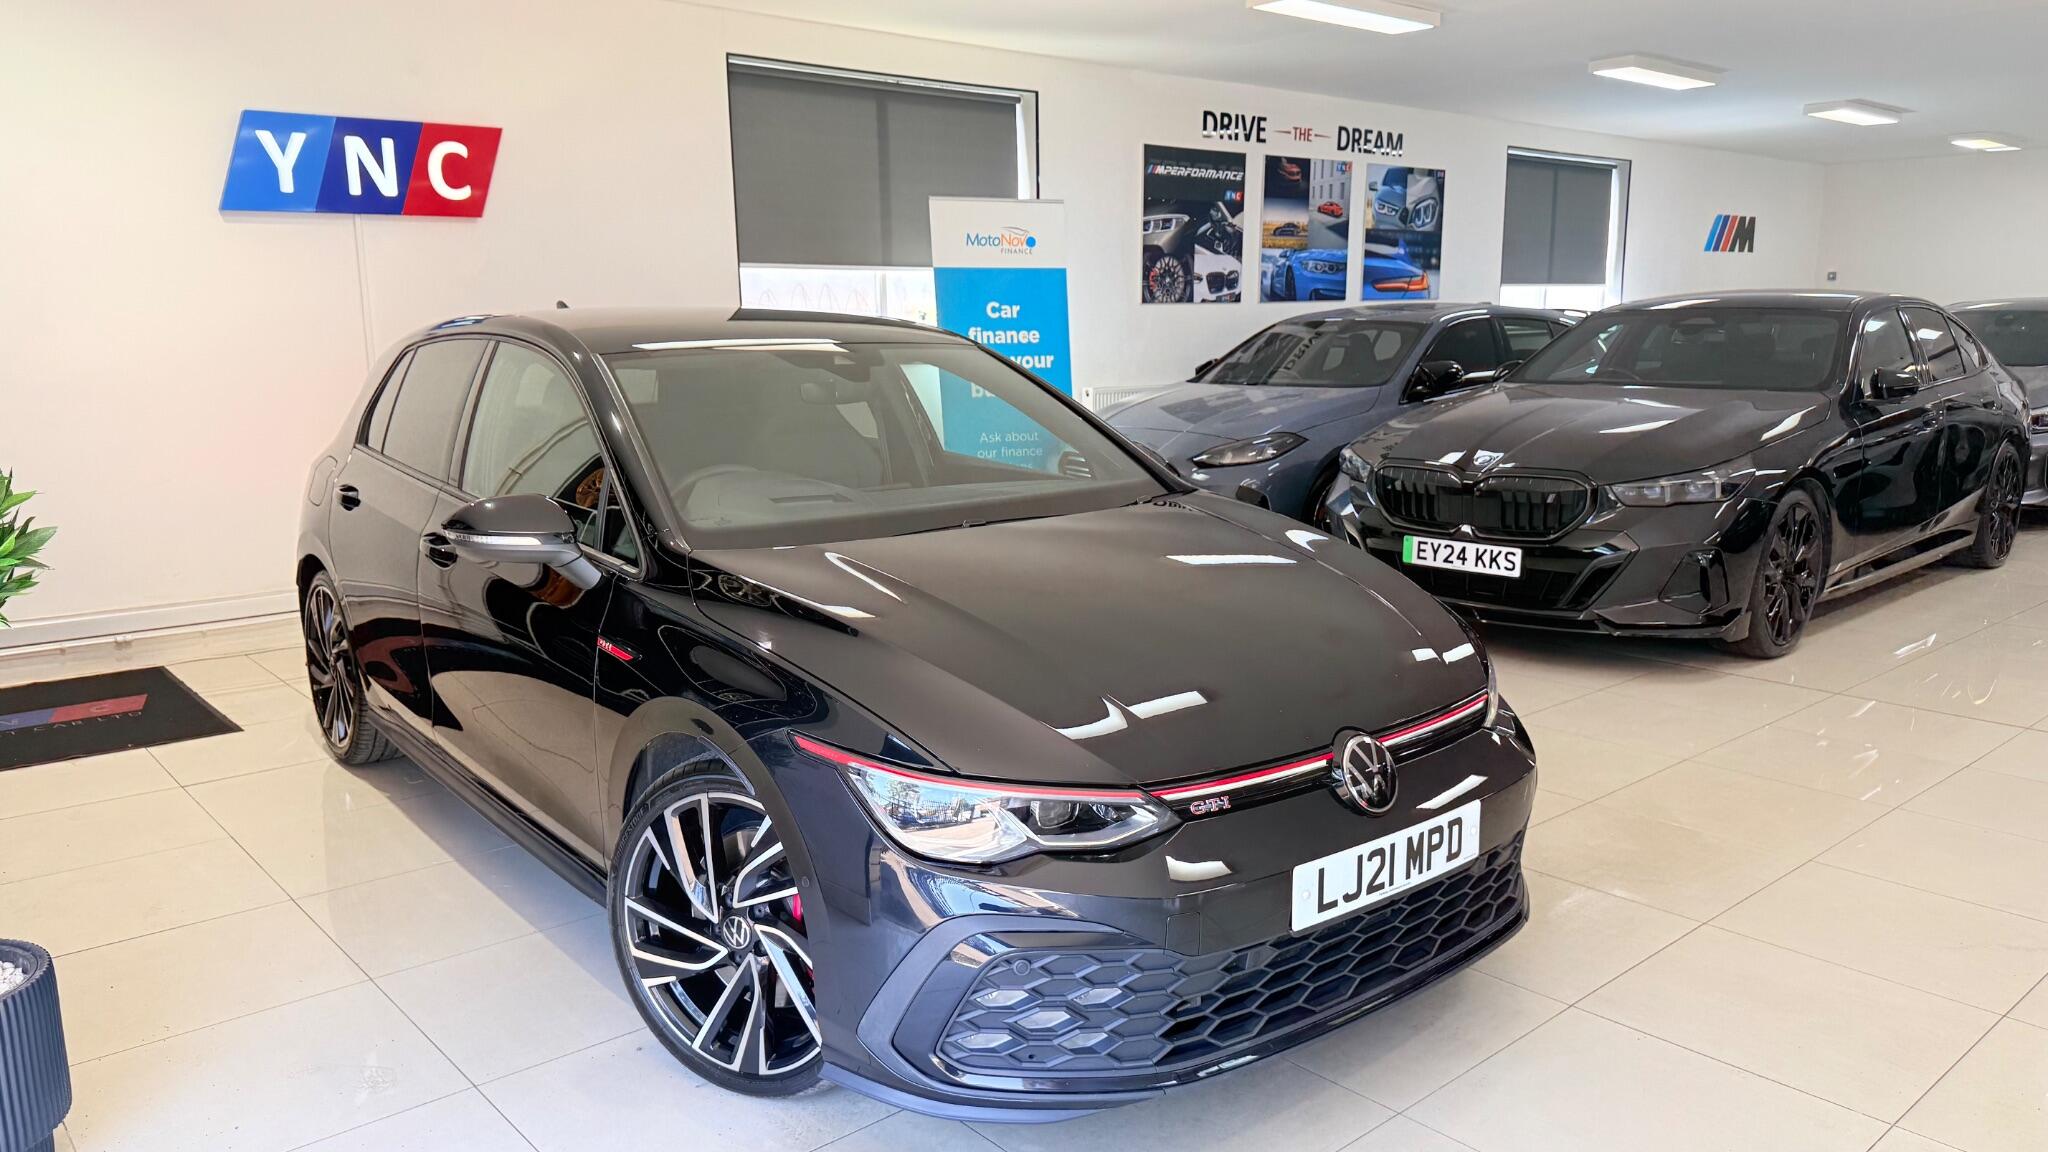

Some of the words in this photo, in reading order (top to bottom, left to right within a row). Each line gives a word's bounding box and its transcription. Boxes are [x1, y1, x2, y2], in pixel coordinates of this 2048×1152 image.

[1202, 110, 1268, 144] DRIVE
[1292, 127, 1313, 143] THE
[1337, 126, 1404, 158] DREAM
[255, 130, 472, 201] YNC
[1000, 247, 1033, 256] FINANCE
[986, 301, 1021, 319] Car
[968, 327, 1041, 345] finance
[980, 431, 1002, 444] Ask
[1004, 431, 1040, 442] about
[976, 448, 997, 459] our
[1001, 445, 1044, 457] finance
[1416, 540, 1468, 566] EY24
[1474, 547, 1517, 572] KKS
[1190, 795, 1232, 816] GTI
[1317, 842, 1396, 914] LJ21
[1405, 816, 1463, 881] MPD
